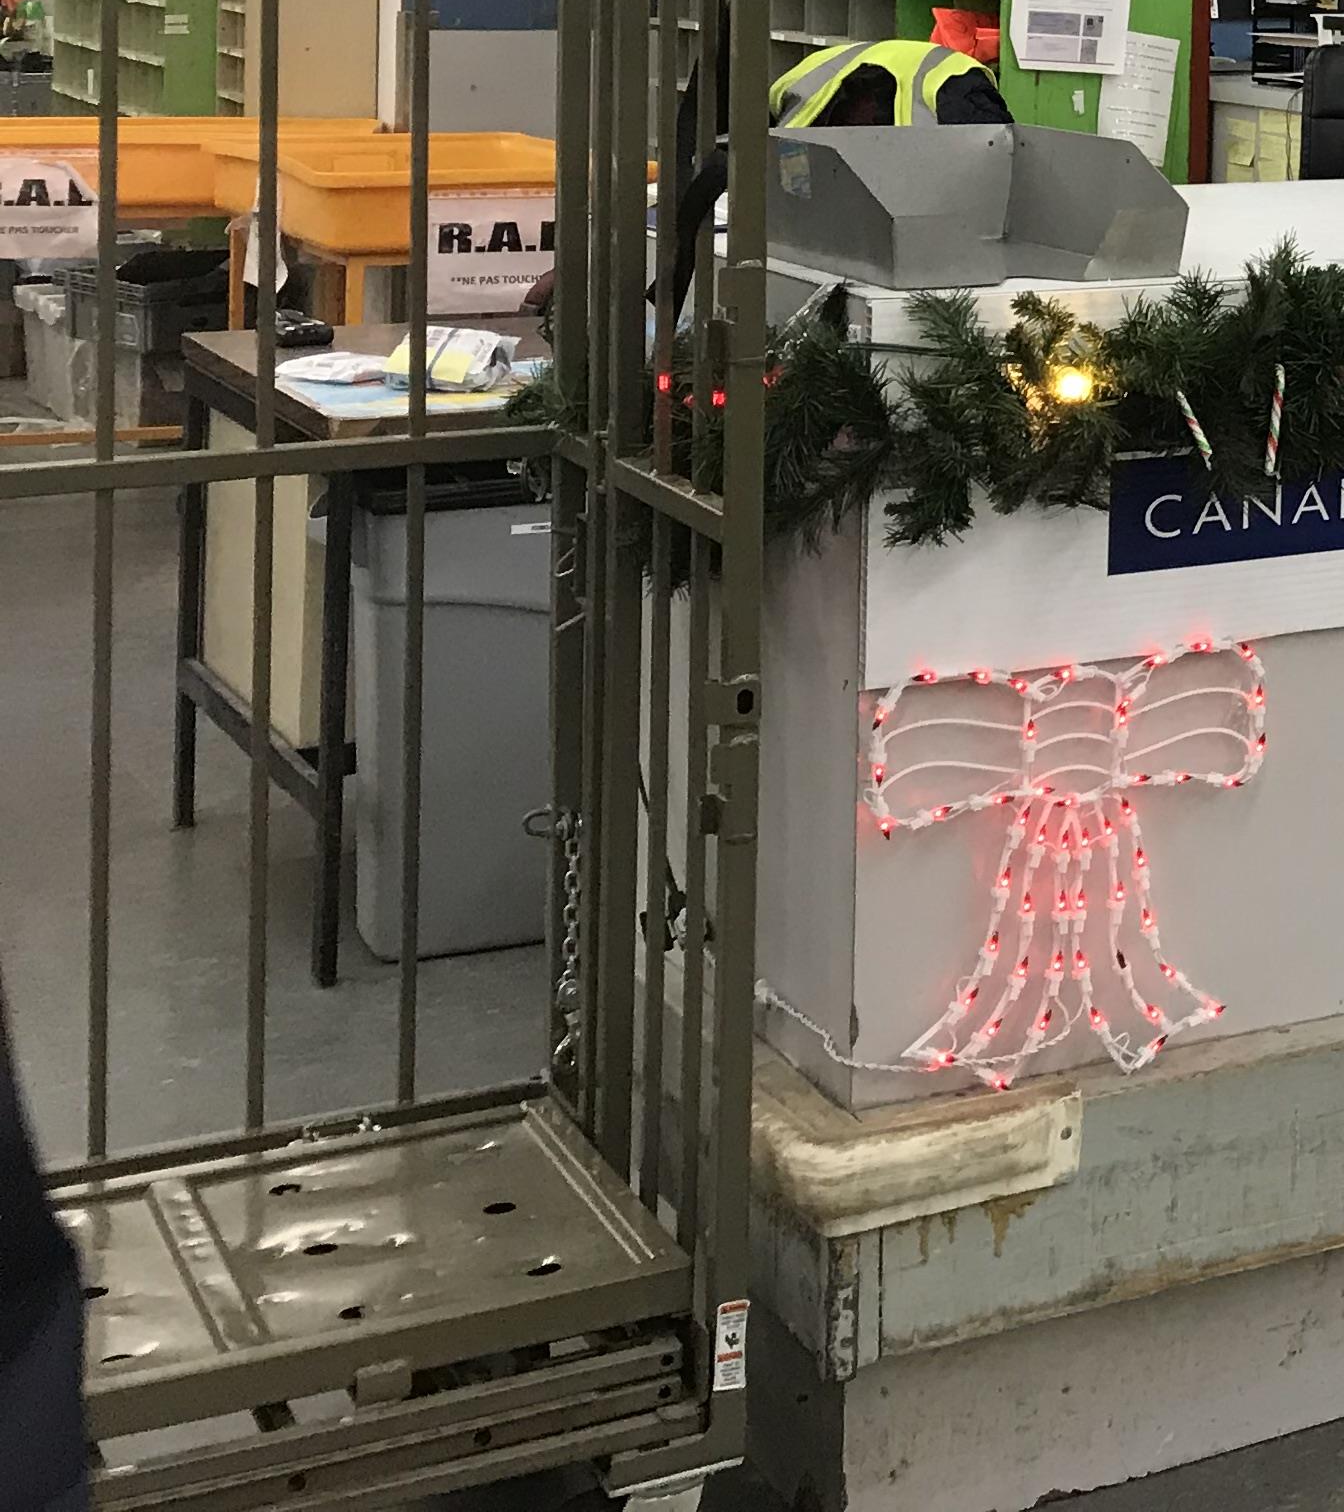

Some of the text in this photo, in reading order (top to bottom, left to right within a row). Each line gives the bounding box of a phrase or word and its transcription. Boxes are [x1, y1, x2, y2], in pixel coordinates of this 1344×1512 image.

[0, 178, 93, 207] .A.L
[8, 226, 29, 234] PAS
[479, 275, 500, 285] PAS
[501, 274, 543, 285] TOUCH
